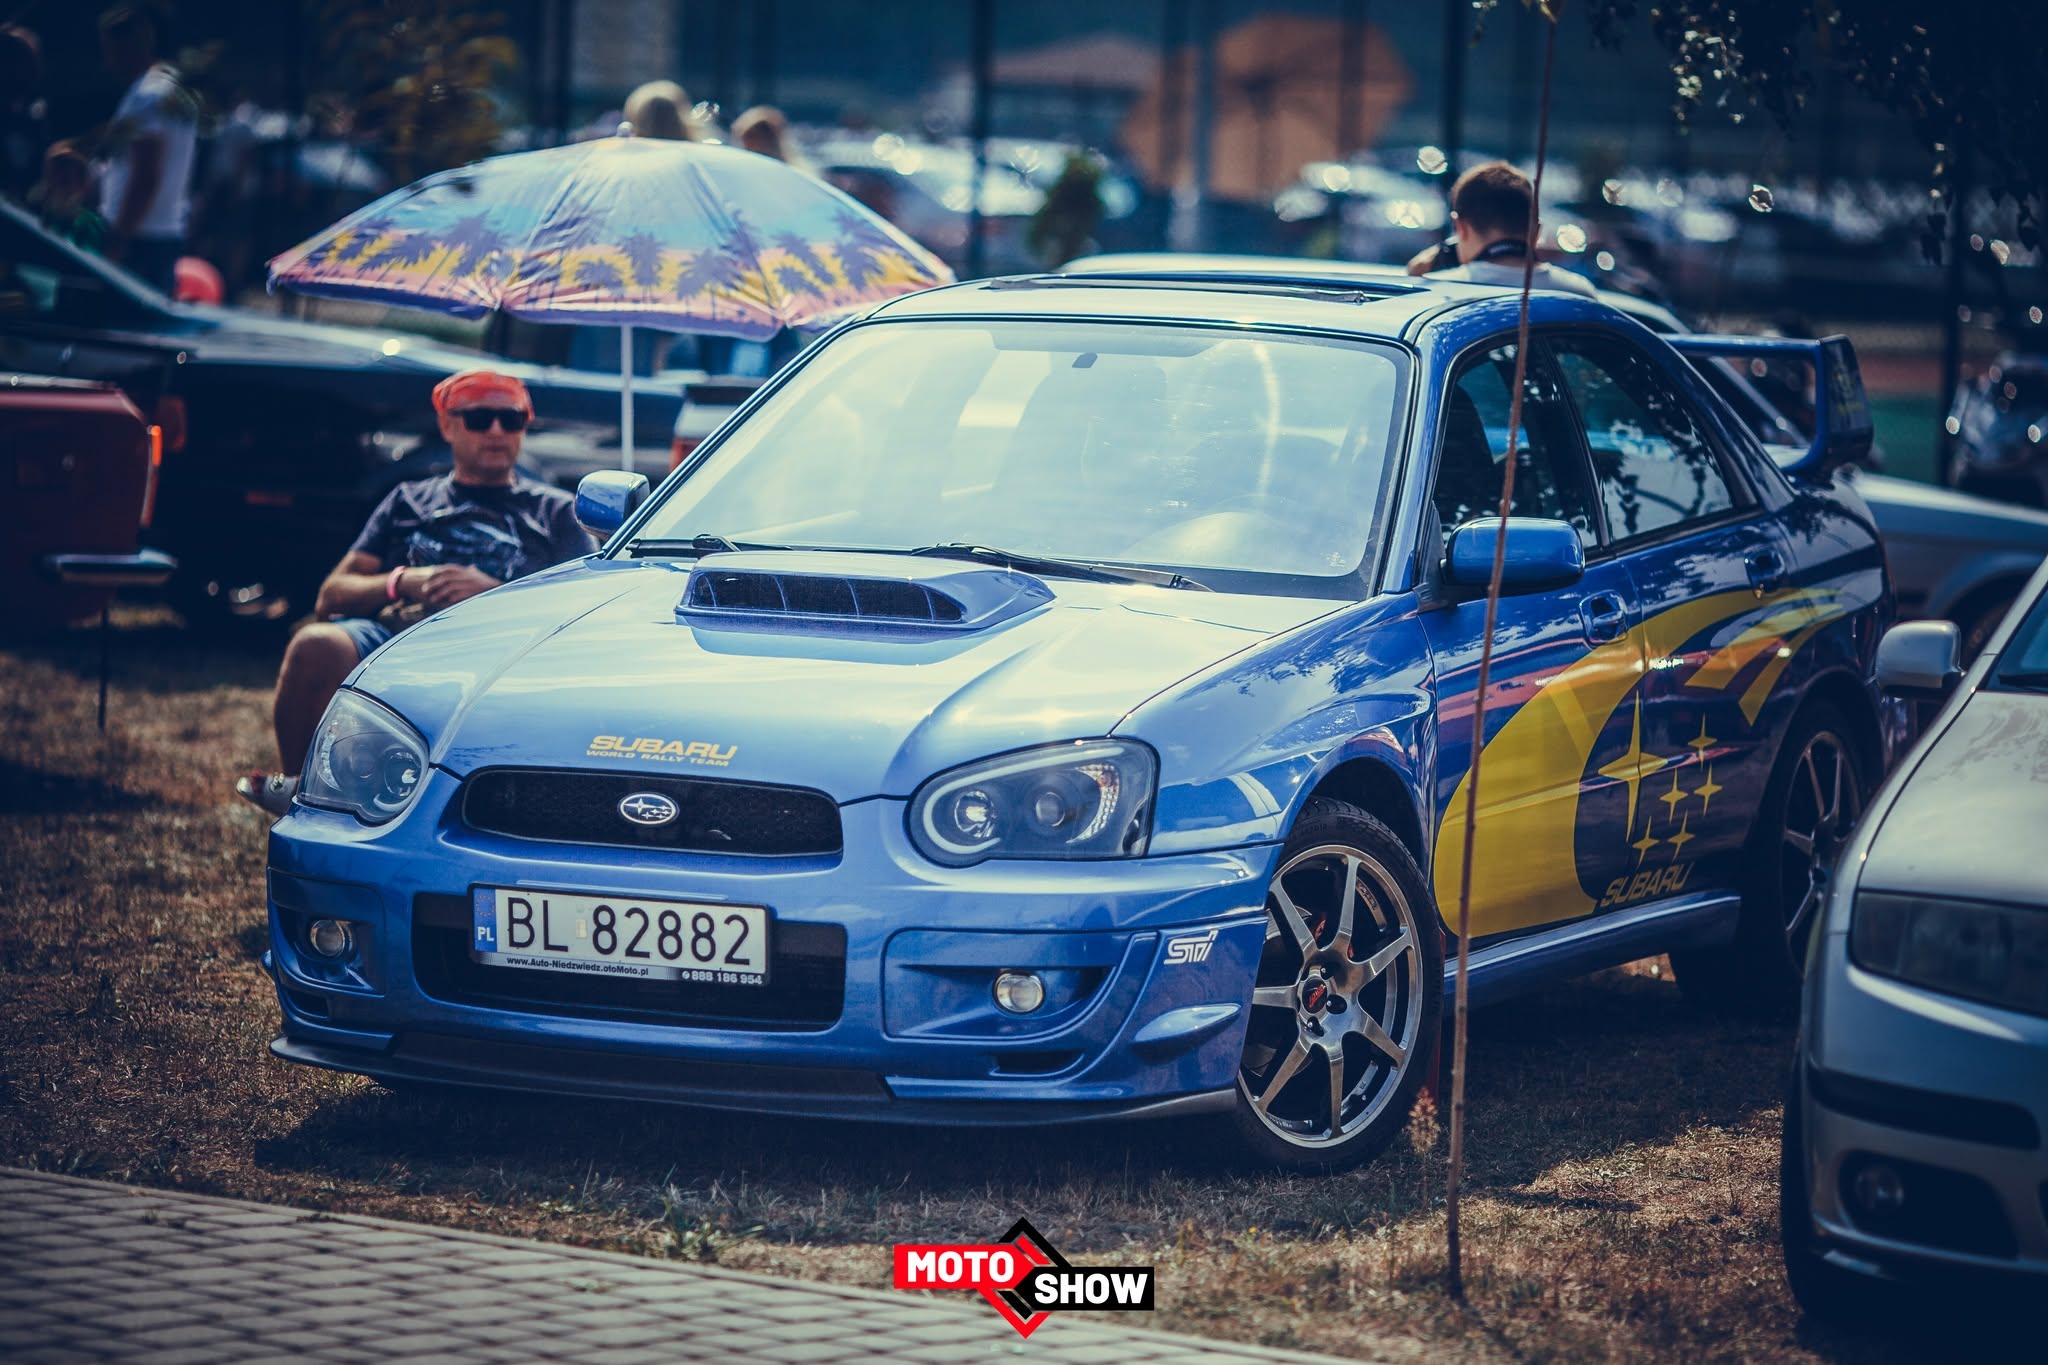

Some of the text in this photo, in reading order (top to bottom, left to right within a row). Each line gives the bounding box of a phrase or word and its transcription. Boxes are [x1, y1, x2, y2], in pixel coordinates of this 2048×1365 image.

[586, 749, 730, 767] WORLD RALLY TEAM
[589, 735, 738, 760] SUBARU
[1600, 861, 1695, 907] SUBARU
[477, 926, 495, 942] PL
[507, 896, 751, 966] BL 82882
